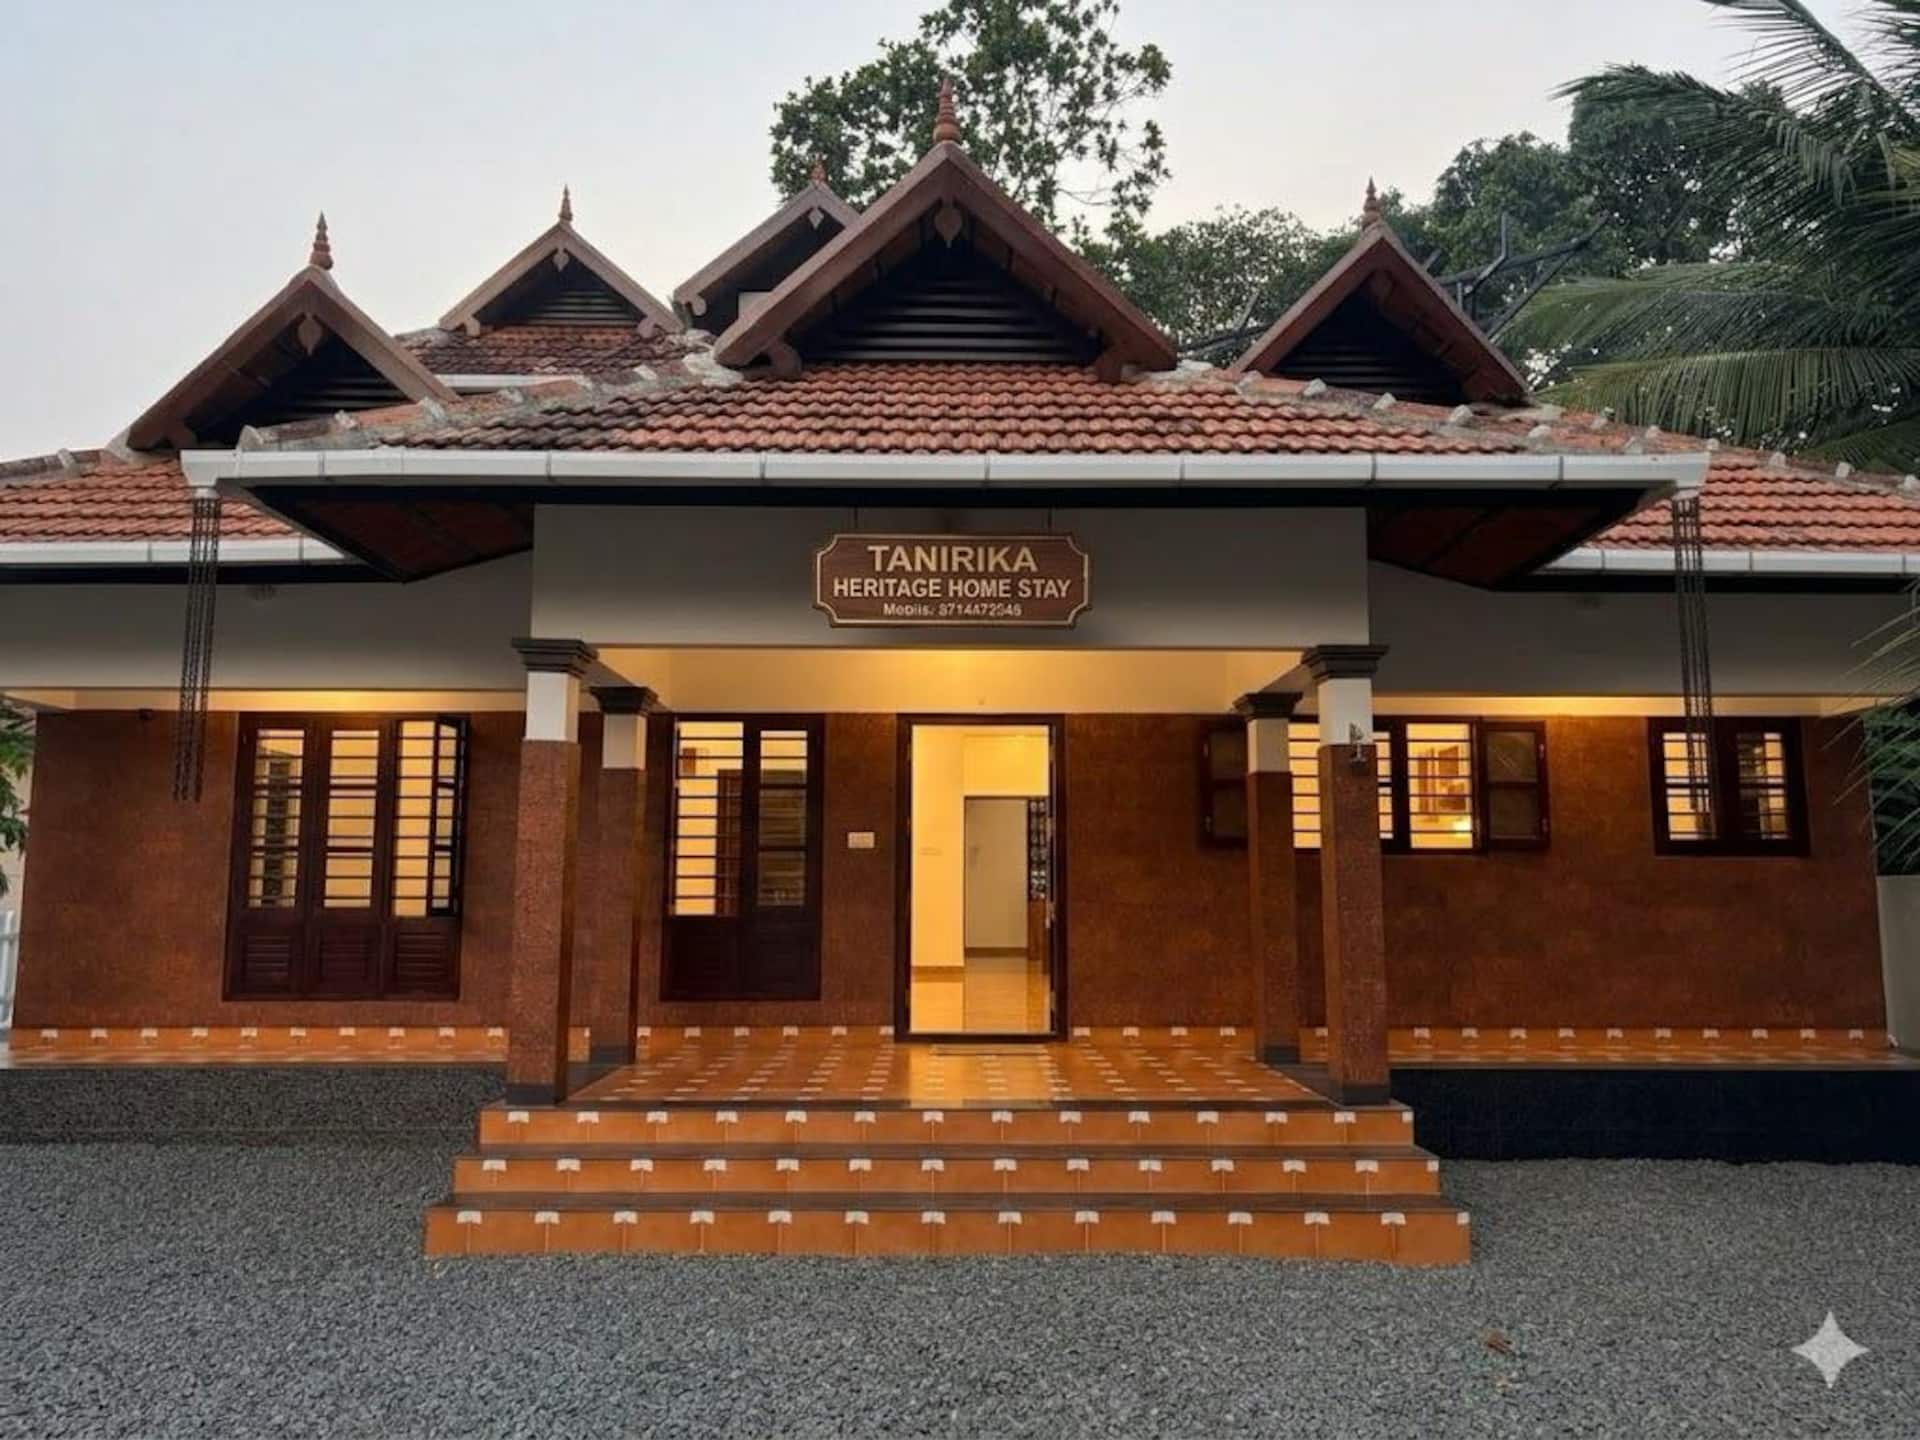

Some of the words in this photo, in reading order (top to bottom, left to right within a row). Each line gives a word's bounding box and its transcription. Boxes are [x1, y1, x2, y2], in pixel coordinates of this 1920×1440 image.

[867, 545, 1039, 573] TANIRIKA
[833, 578, 943, 598] HERITAGE
[949, 578, 1012, 598] HOME
[1017, 578, 1073, 598] STAY
